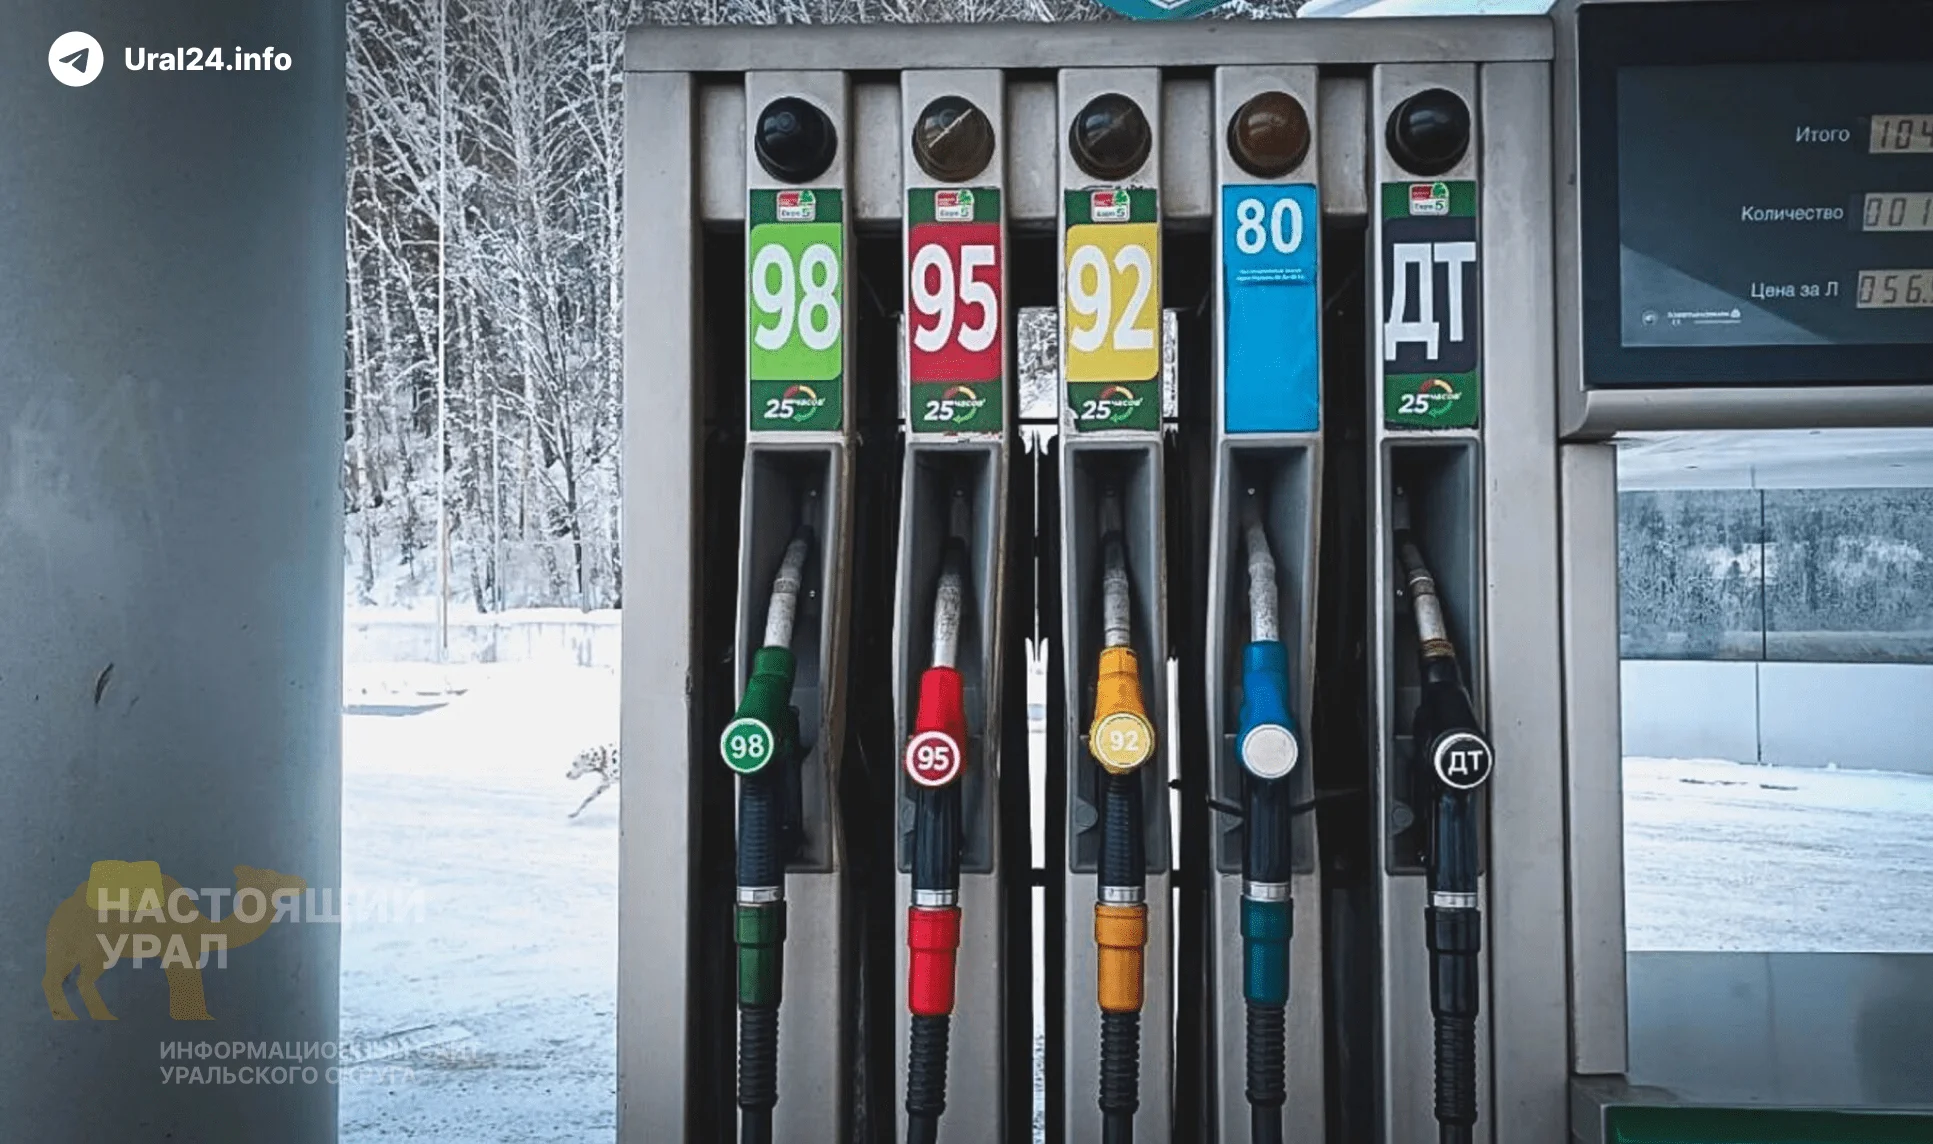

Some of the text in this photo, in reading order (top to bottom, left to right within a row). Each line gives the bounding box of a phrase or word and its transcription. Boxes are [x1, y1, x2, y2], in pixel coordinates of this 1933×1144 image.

[1796, 126, 1850, 142] Итого
[1880, 119, 1933, 149] 104
[1741, 206, 1844, 221] Количество
[1236, 198, 1303, 254] 80
[752, 243, 842, 351] 98
[911, 243, 998, 352] 95
[1068, 244, 1155, 351] 92
[1751, 282, 1839, 299] Цена за Л
[1859, 274, 1933, 303] 056.
[1384, 242, 1477, 360] ДТ
[764, 398, 794, 419] 25
[924, 400, 954, 421] 25
[1081, 400, 1111, 420] 25
[1398, 393, 1429, 414] 25
[731, 735, 764, 759] 98
[1110, 730, 1140, 752] 92
[917, 746, 950, 771] 95
[1447, 750, 1483, 776] ДТ
